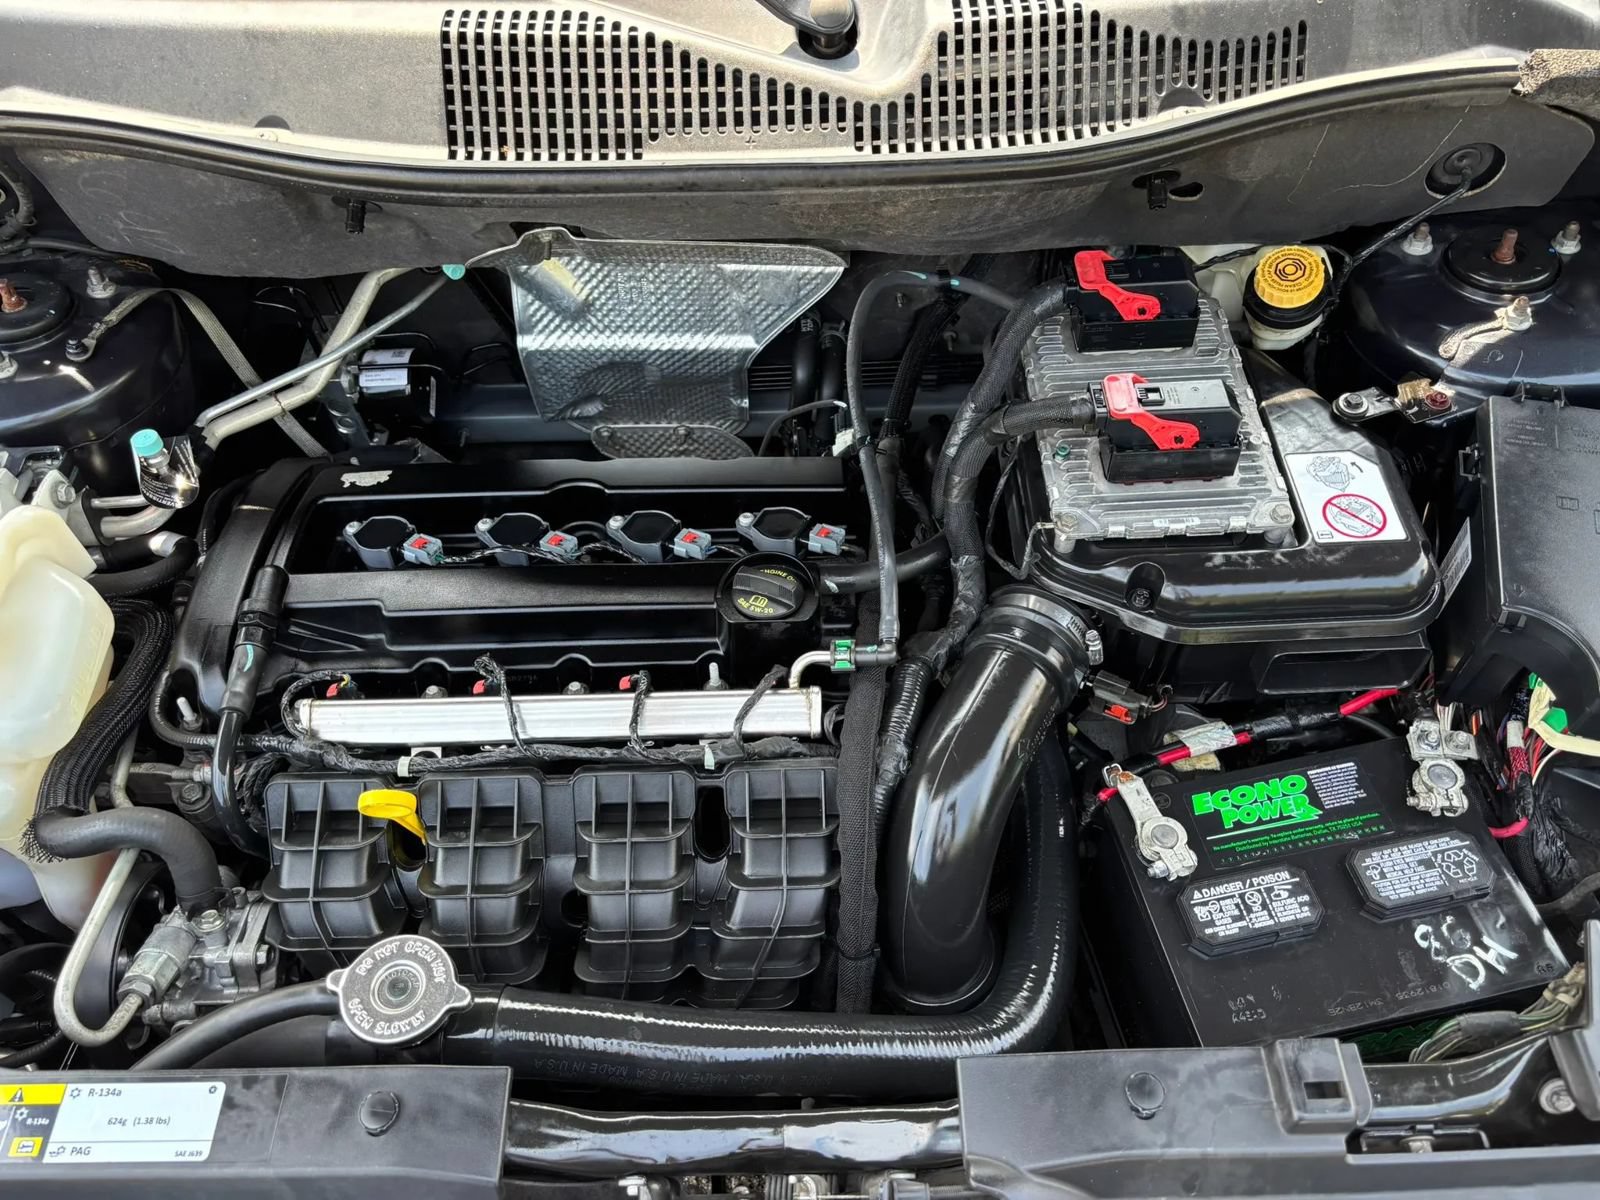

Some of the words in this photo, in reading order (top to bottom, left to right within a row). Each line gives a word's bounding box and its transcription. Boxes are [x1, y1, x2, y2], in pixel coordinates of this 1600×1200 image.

[1192, 774, 1308, 816] ECONO
[1221, 794, 1322, 829] POWER
[1202, 881, 1245, 897] DANGER
[1243, 880, 1253, 888] /
[1252, 871, 1290, 886] POISON
[356, 958, 374, 976] DO
[374, 942, 400, 961] NOT
[404, 941, 436, 962] OPEN
[430, 959, 446, 984] HOT
[1446, 935, 1518, 990] DH
[348, 998, 374, 1030] OPEN
[374, 1010, 426, 1036] SLOWLY
[88, 1088, 122, 1097] R-134a
[107, 1116, 128, 1127] 624g
[133, 1116, 154, 1127] (1.38
[155, 1116, 171, 1126] lbs)
[70, 1146, 92, 1156] PAG
